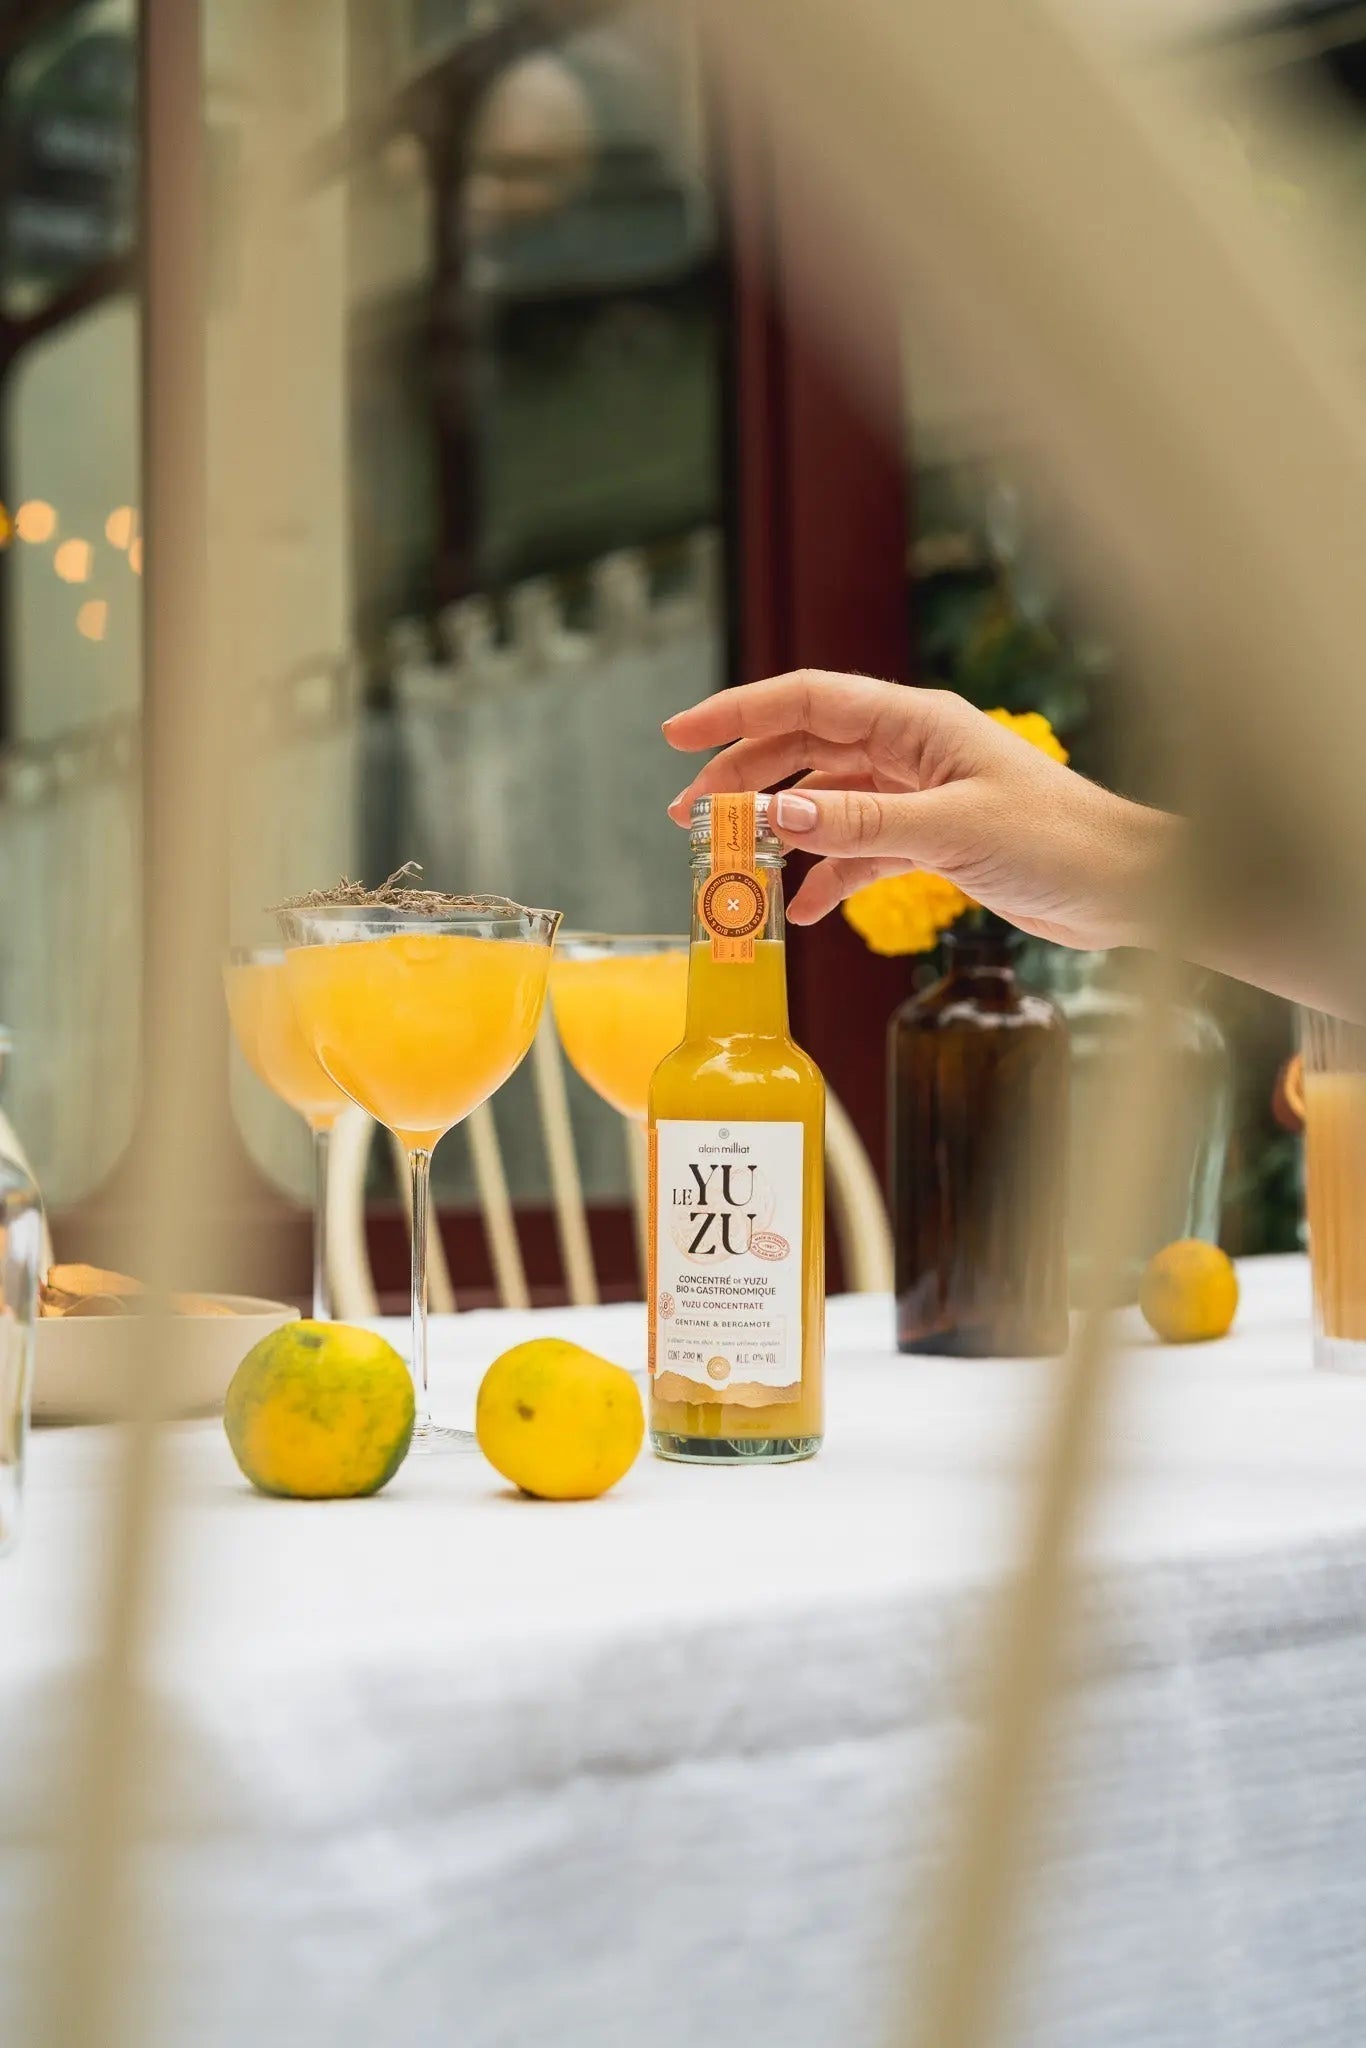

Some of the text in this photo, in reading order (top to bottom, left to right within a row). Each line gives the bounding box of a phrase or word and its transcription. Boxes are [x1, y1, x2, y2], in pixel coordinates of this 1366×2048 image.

[727, 805, 740, 852] Concentré
[704, 875, 735, 921] gastronomique
[715, 926, 729, 935] BIO
[735, 924, 754, 935] yuzu
[698, 1142, 750, 1154] alain milliat
[672, 1164, 757, 1207] LE YU
[688, 1212, 757, 1255] ZU
[678, 1275, 731, 1285] CONCENTRÉ
[743, 1277, 768, 1286] YUZU
[676, 1285, 689, 1294] BIO
[696, 1286, 776, 1297] GASTRONOMIQUE
[681, 1300, 764, 1310] YUZU CONCENTRATE
[675, 1318, 710, 1327] GENTIANE
[682, 1351, 695, 1360] 200
